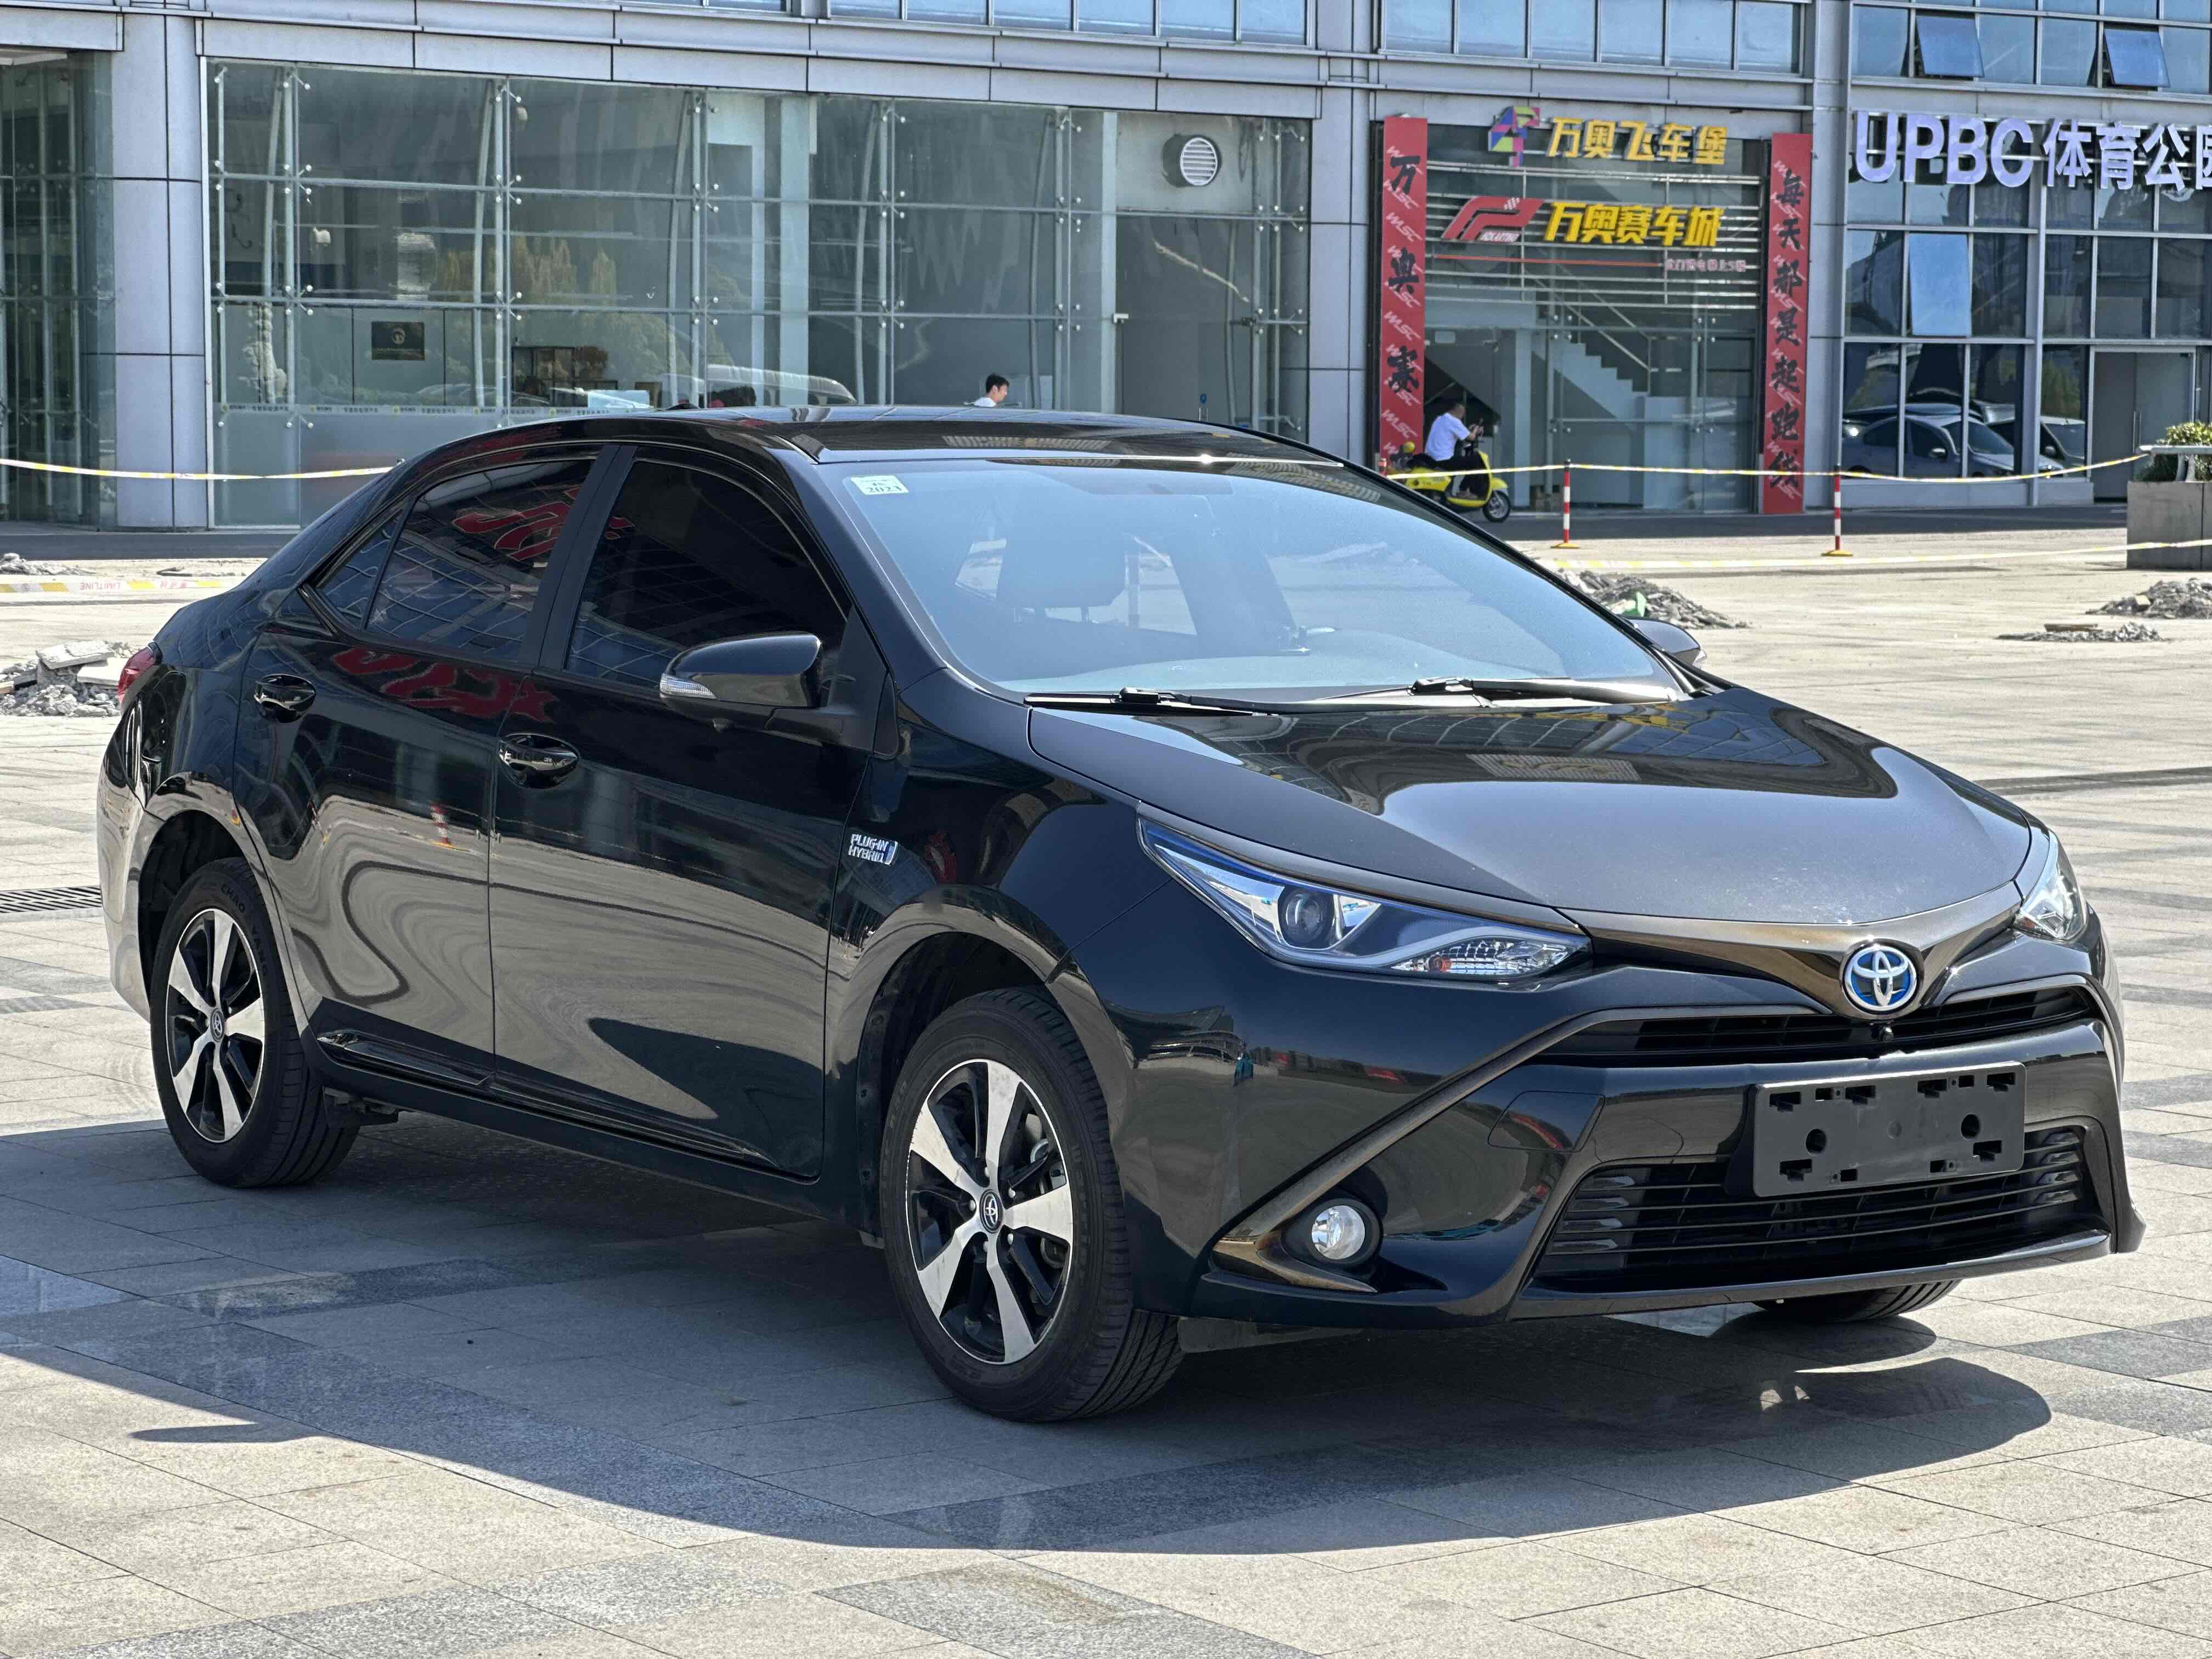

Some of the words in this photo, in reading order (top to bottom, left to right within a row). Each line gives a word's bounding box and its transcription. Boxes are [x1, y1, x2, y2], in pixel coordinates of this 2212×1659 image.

[1547, 116, 1728, 165] 万奥飞车堡
[1855, 111, 2034, 187] UPBC
[1544, 201, 1723, 247] 万奥赛车城
[848, 844, 884, 863] HYBRID
